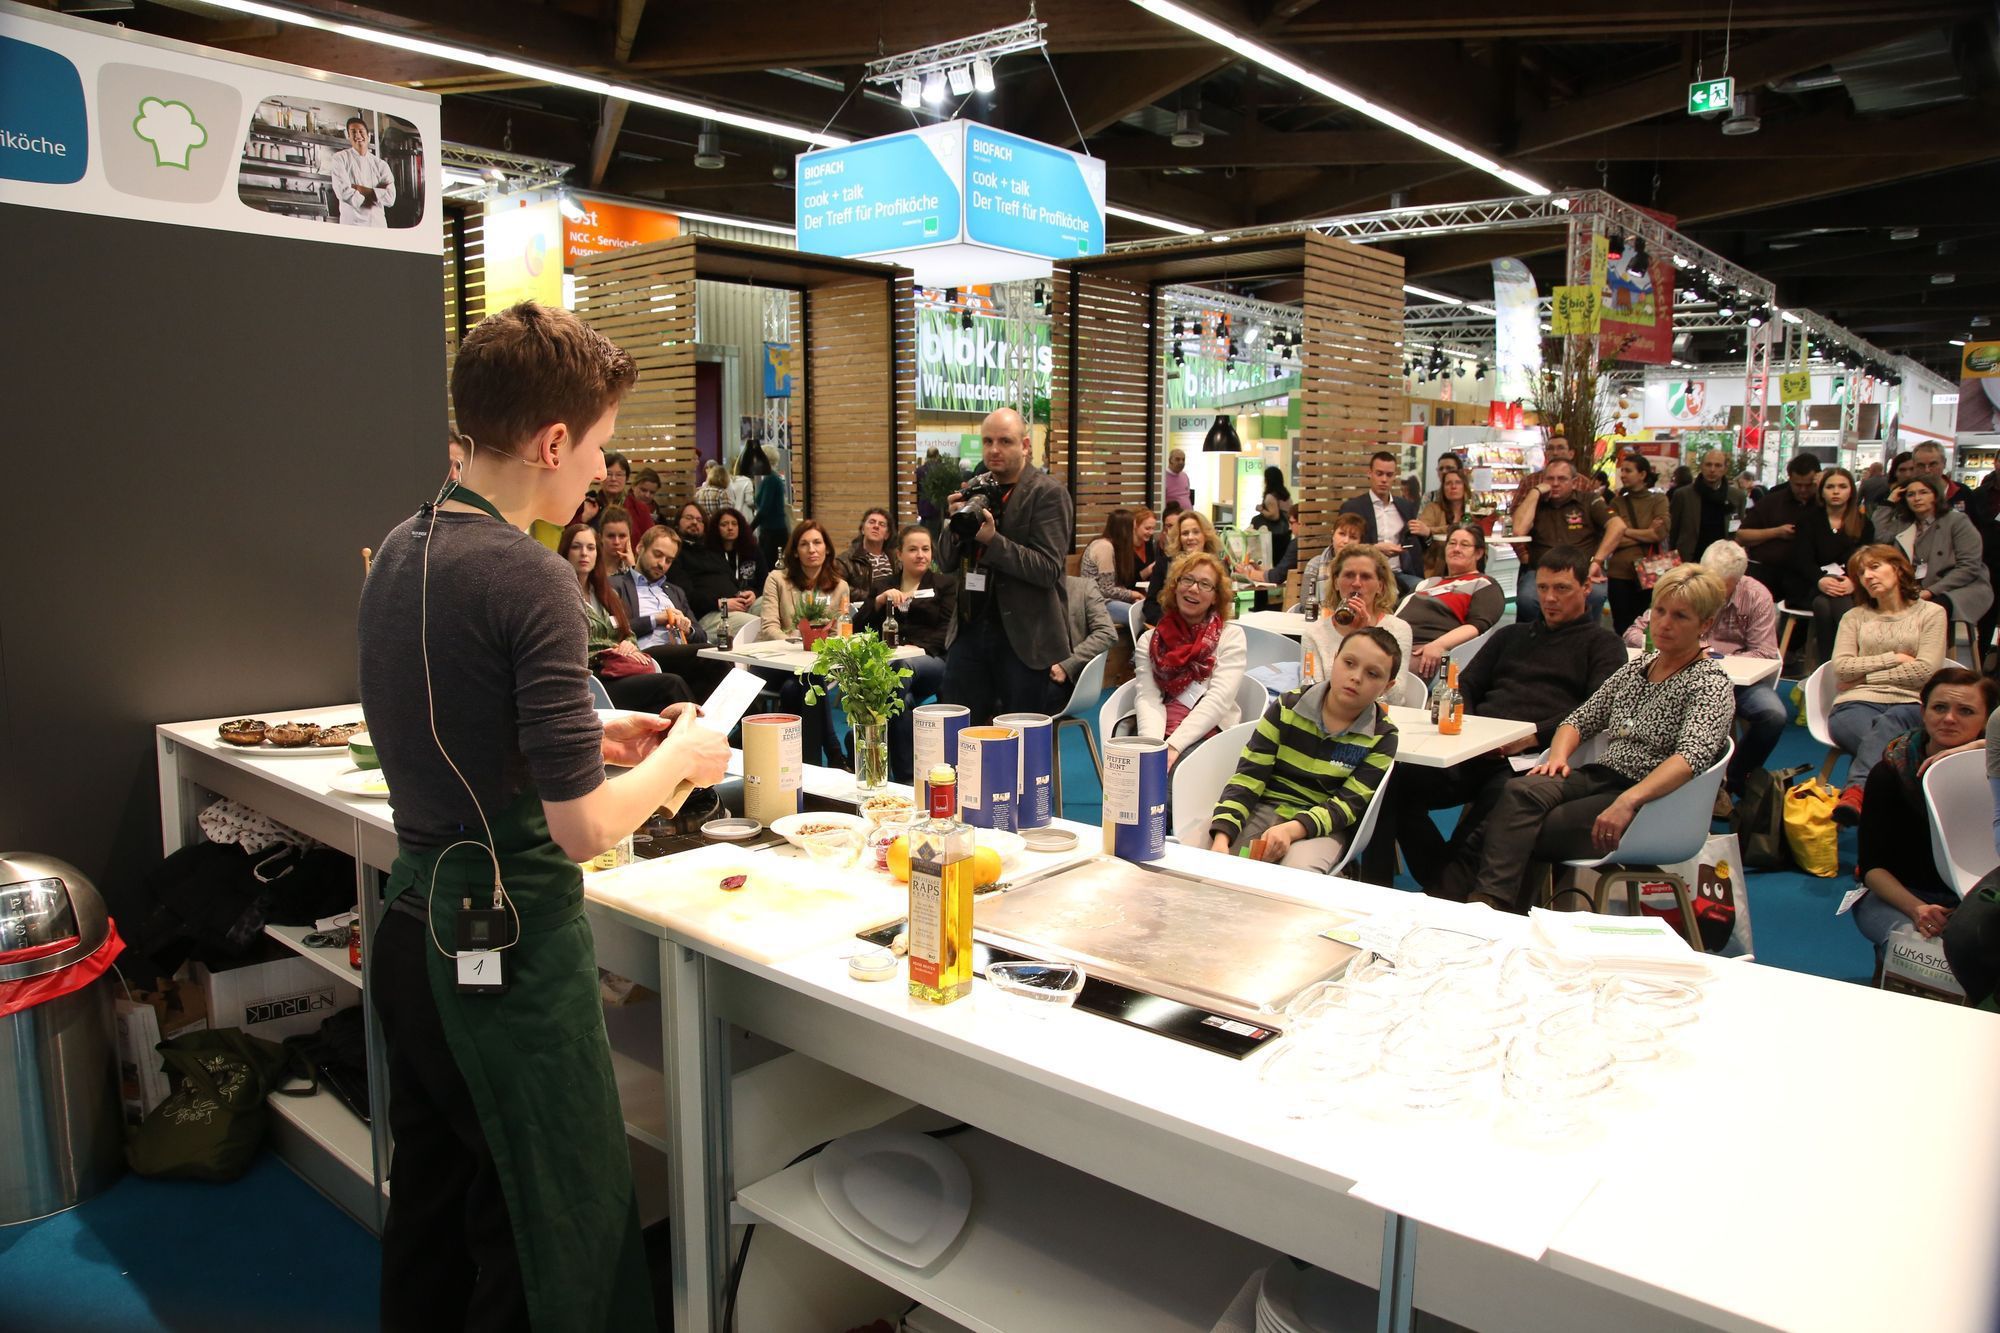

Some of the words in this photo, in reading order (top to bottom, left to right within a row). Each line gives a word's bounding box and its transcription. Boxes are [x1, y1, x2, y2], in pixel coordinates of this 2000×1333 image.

[973, 138, 1013, 162] BIOFACH
[804, 161, 844, 180] BIOFACH
[973, 170, 998, 189] cook
[1001, 177, 1008, 187] +
[1011, 178, 1030, 197] talk
[804, 190, 829, 208] cook
[832, 191, 839, 200] +
[842, 184, 864, 202] talk
[804, 214, 823, 230] Der
[826, 207, 852, 226] Treff
[855, 204, 872, 221] für
[875, 194, 939, 218] Profiköche
[973, 191, 992, 210] Der
[995, 195, 1020, 216] Treff
[1022, 201, 1038, 221] für
[1039, 206, 1089, 233] Profiköche
[569, 231, 590, 243] NCC
[1569, 299, 1585, 308] bio
[923, 373, 951, 398] Wir
[954, 376, 1005, 401] machen
[912, 880, 940, 897] RAPS
[473, 959, 484, 976] 1
